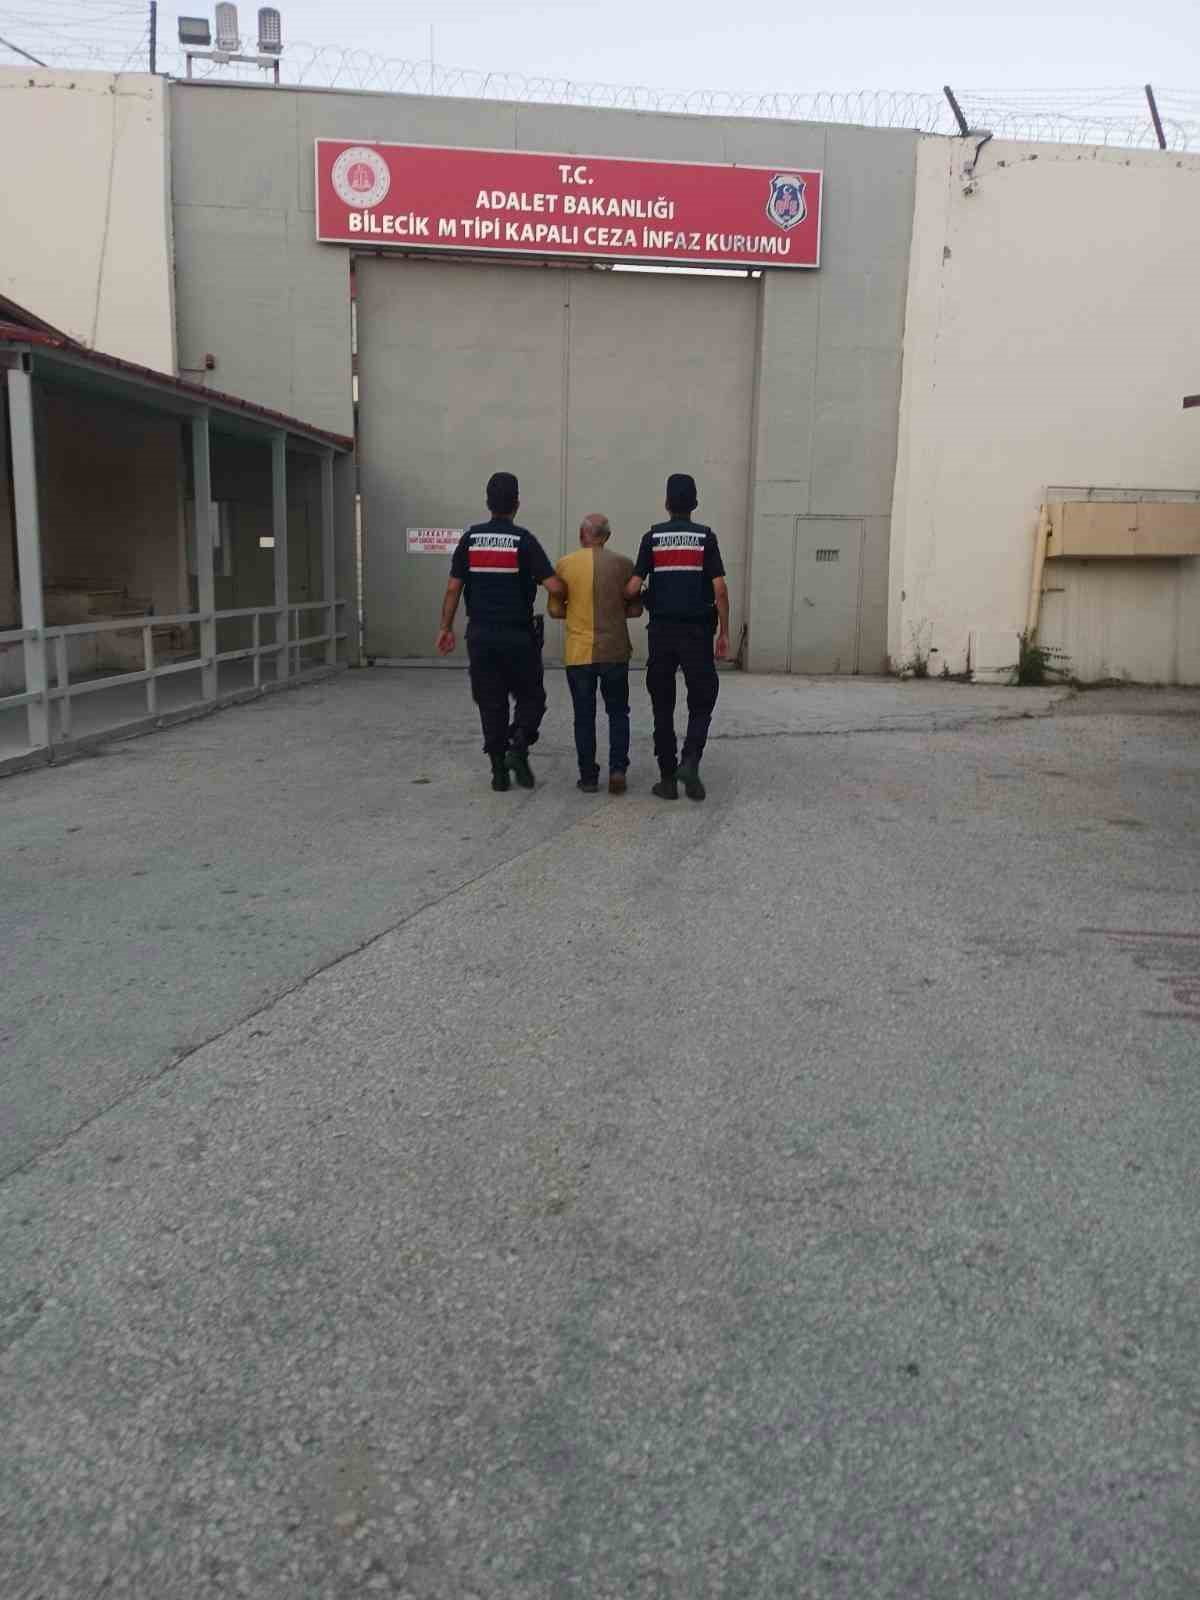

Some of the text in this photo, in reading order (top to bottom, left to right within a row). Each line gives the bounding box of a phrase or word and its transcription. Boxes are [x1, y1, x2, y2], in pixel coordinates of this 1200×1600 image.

[558, 164, 594, 185] T.C.
[476, 190, 675, 220] ADALET BAKANLIĞI
[349, 209, 791, 255] BİLECİK M TİPİ KAPALI CEZA İNFAZ KURUMU
